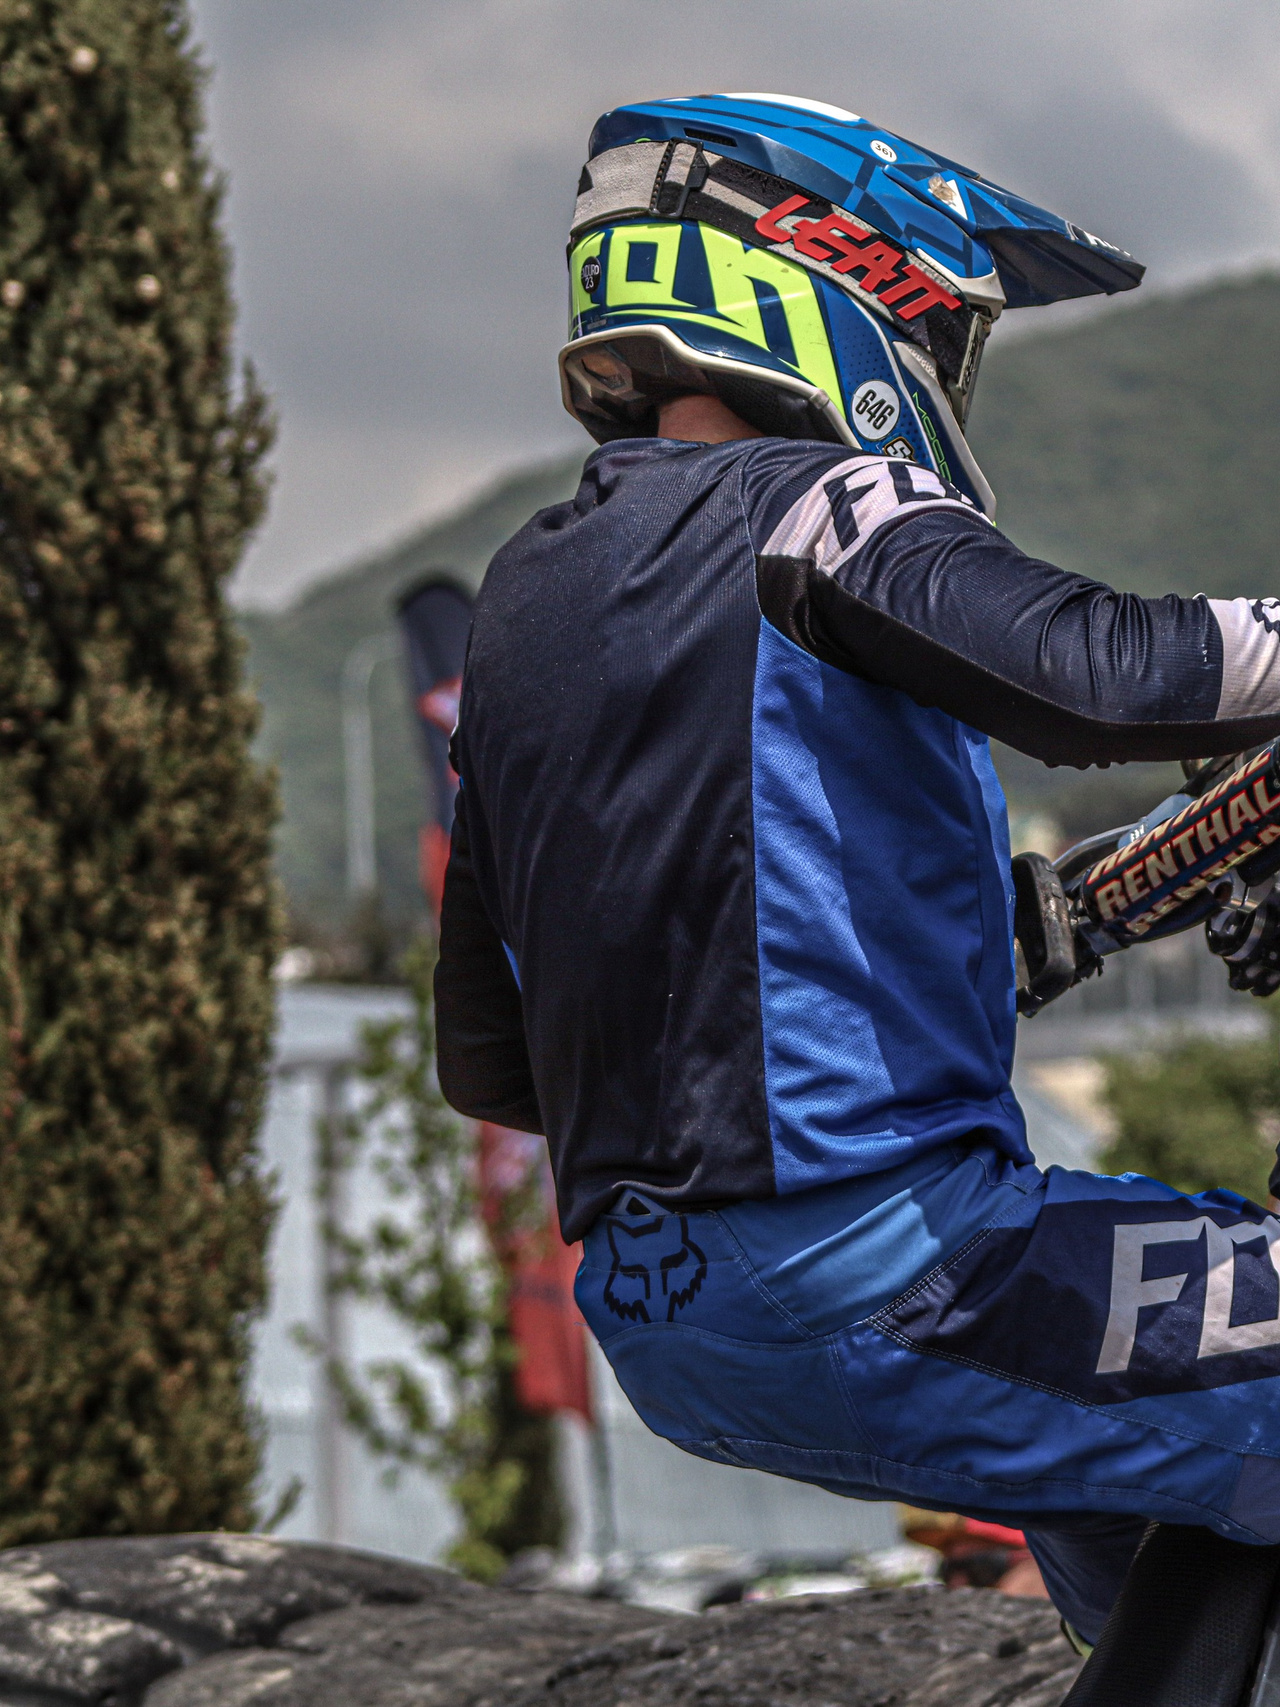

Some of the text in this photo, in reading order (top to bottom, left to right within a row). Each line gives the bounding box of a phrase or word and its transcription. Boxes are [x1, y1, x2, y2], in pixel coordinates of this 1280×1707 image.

[584, 276, 595, 290] 23
[754, 193, 962, 321] LEATT
[855, 389, 896, 431] 646
[822, 460, 977, 551] FO
